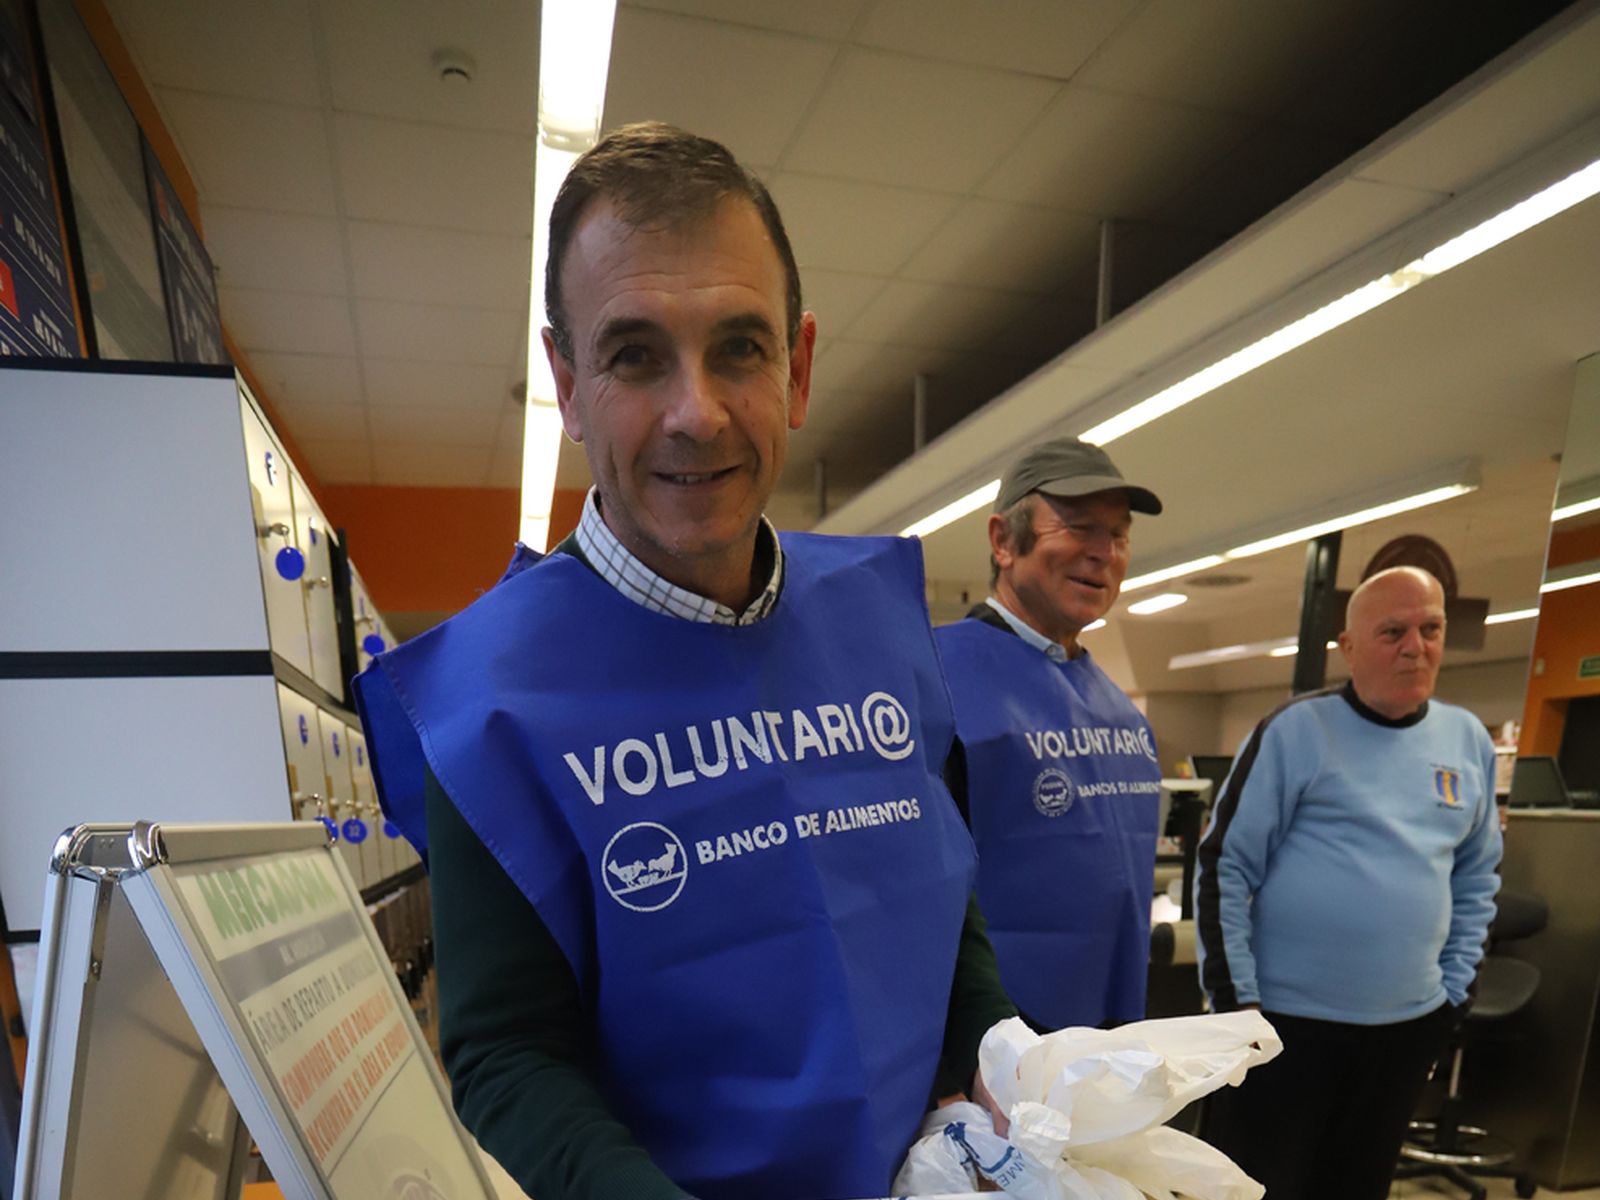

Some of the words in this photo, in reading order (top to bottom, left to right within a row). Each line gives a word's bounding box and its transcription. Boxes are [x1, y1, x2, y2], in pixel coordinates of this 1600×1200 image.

[563, 691, 916, 806] VOLUNTARI@
[695, 821, 788, 865] BANCO
[794, 813, 821, 838] DE
[824, 797, 921, 835] ALIMENTOS
